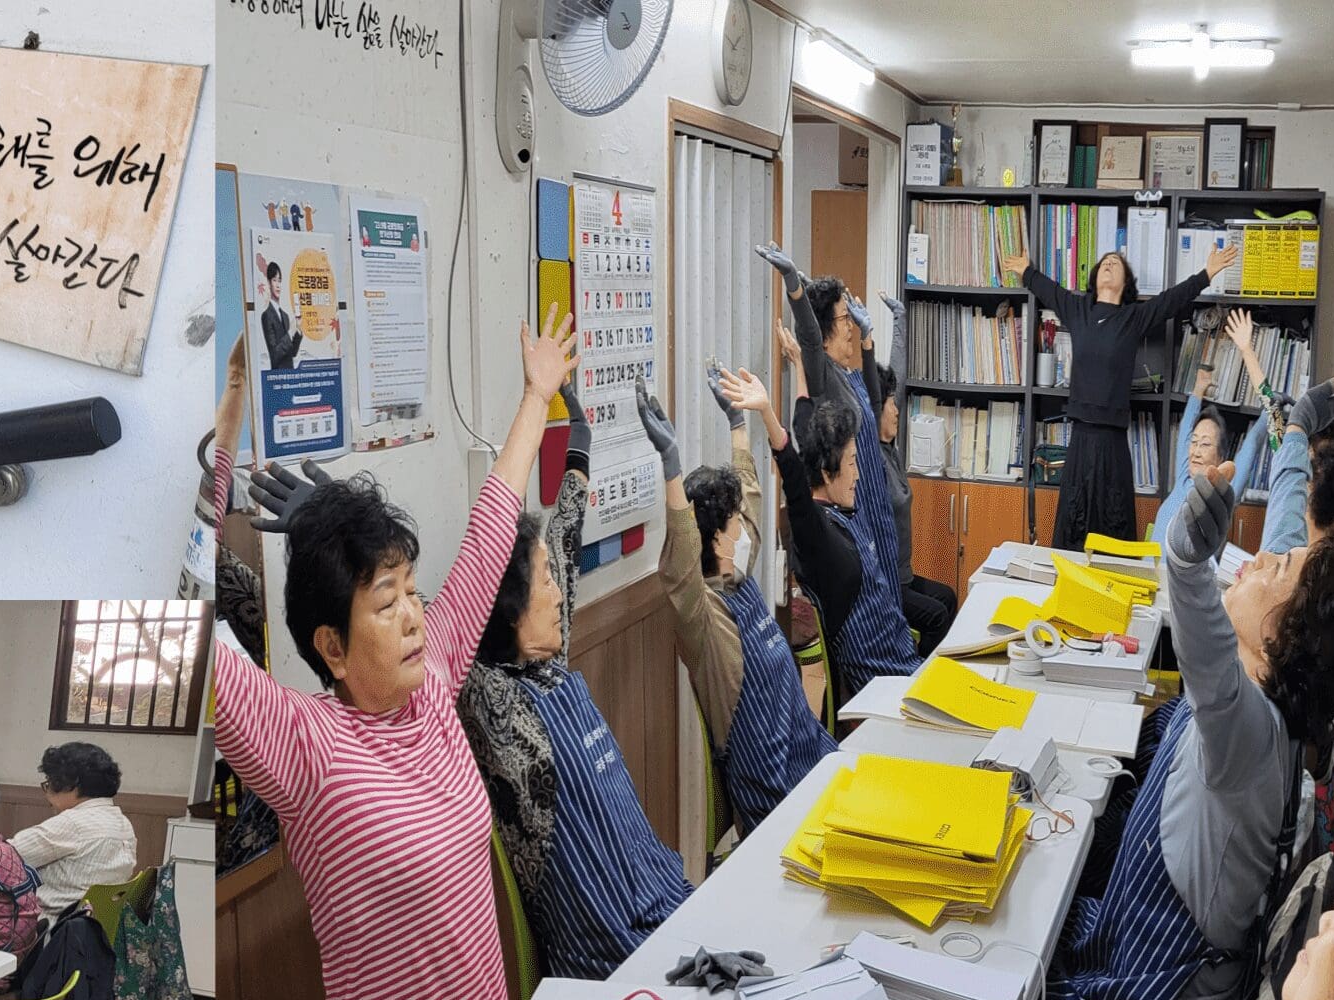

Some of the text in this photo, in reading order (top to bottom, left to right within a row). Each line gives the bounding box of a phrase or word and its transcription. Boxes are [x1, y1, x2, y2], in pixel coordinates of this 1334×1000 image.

[390, 14, 444, 70] 살아간다
[73, 135, 165, 212] 위해
[612, 190, 622, 226] 4
[596, 254, 600, 272] 1
[606, 254, 611, 272] 2
[616, 255, 621, 272] 3
[627, 255, 631, 272] 4
[636, 256, 641, 272] 5
[585, 292, 651, 310] 7 8 9 10 11 12 13
[584, 326, 653, 349] 14 15 16 17 18 19 20
[585, 369, 593, 388] 21
[596, 367, 605, 386] 22
[607, 366, 615, 384] 23
[617, 364, 625, 382] 24
[627, 363, 635, 380] 25
[645, 361, 653, 378] 27
[596, 405, 605, 423] 29
[607, 403, 615, 421] 30
[969, 686, 1017, 704] COGNEX
